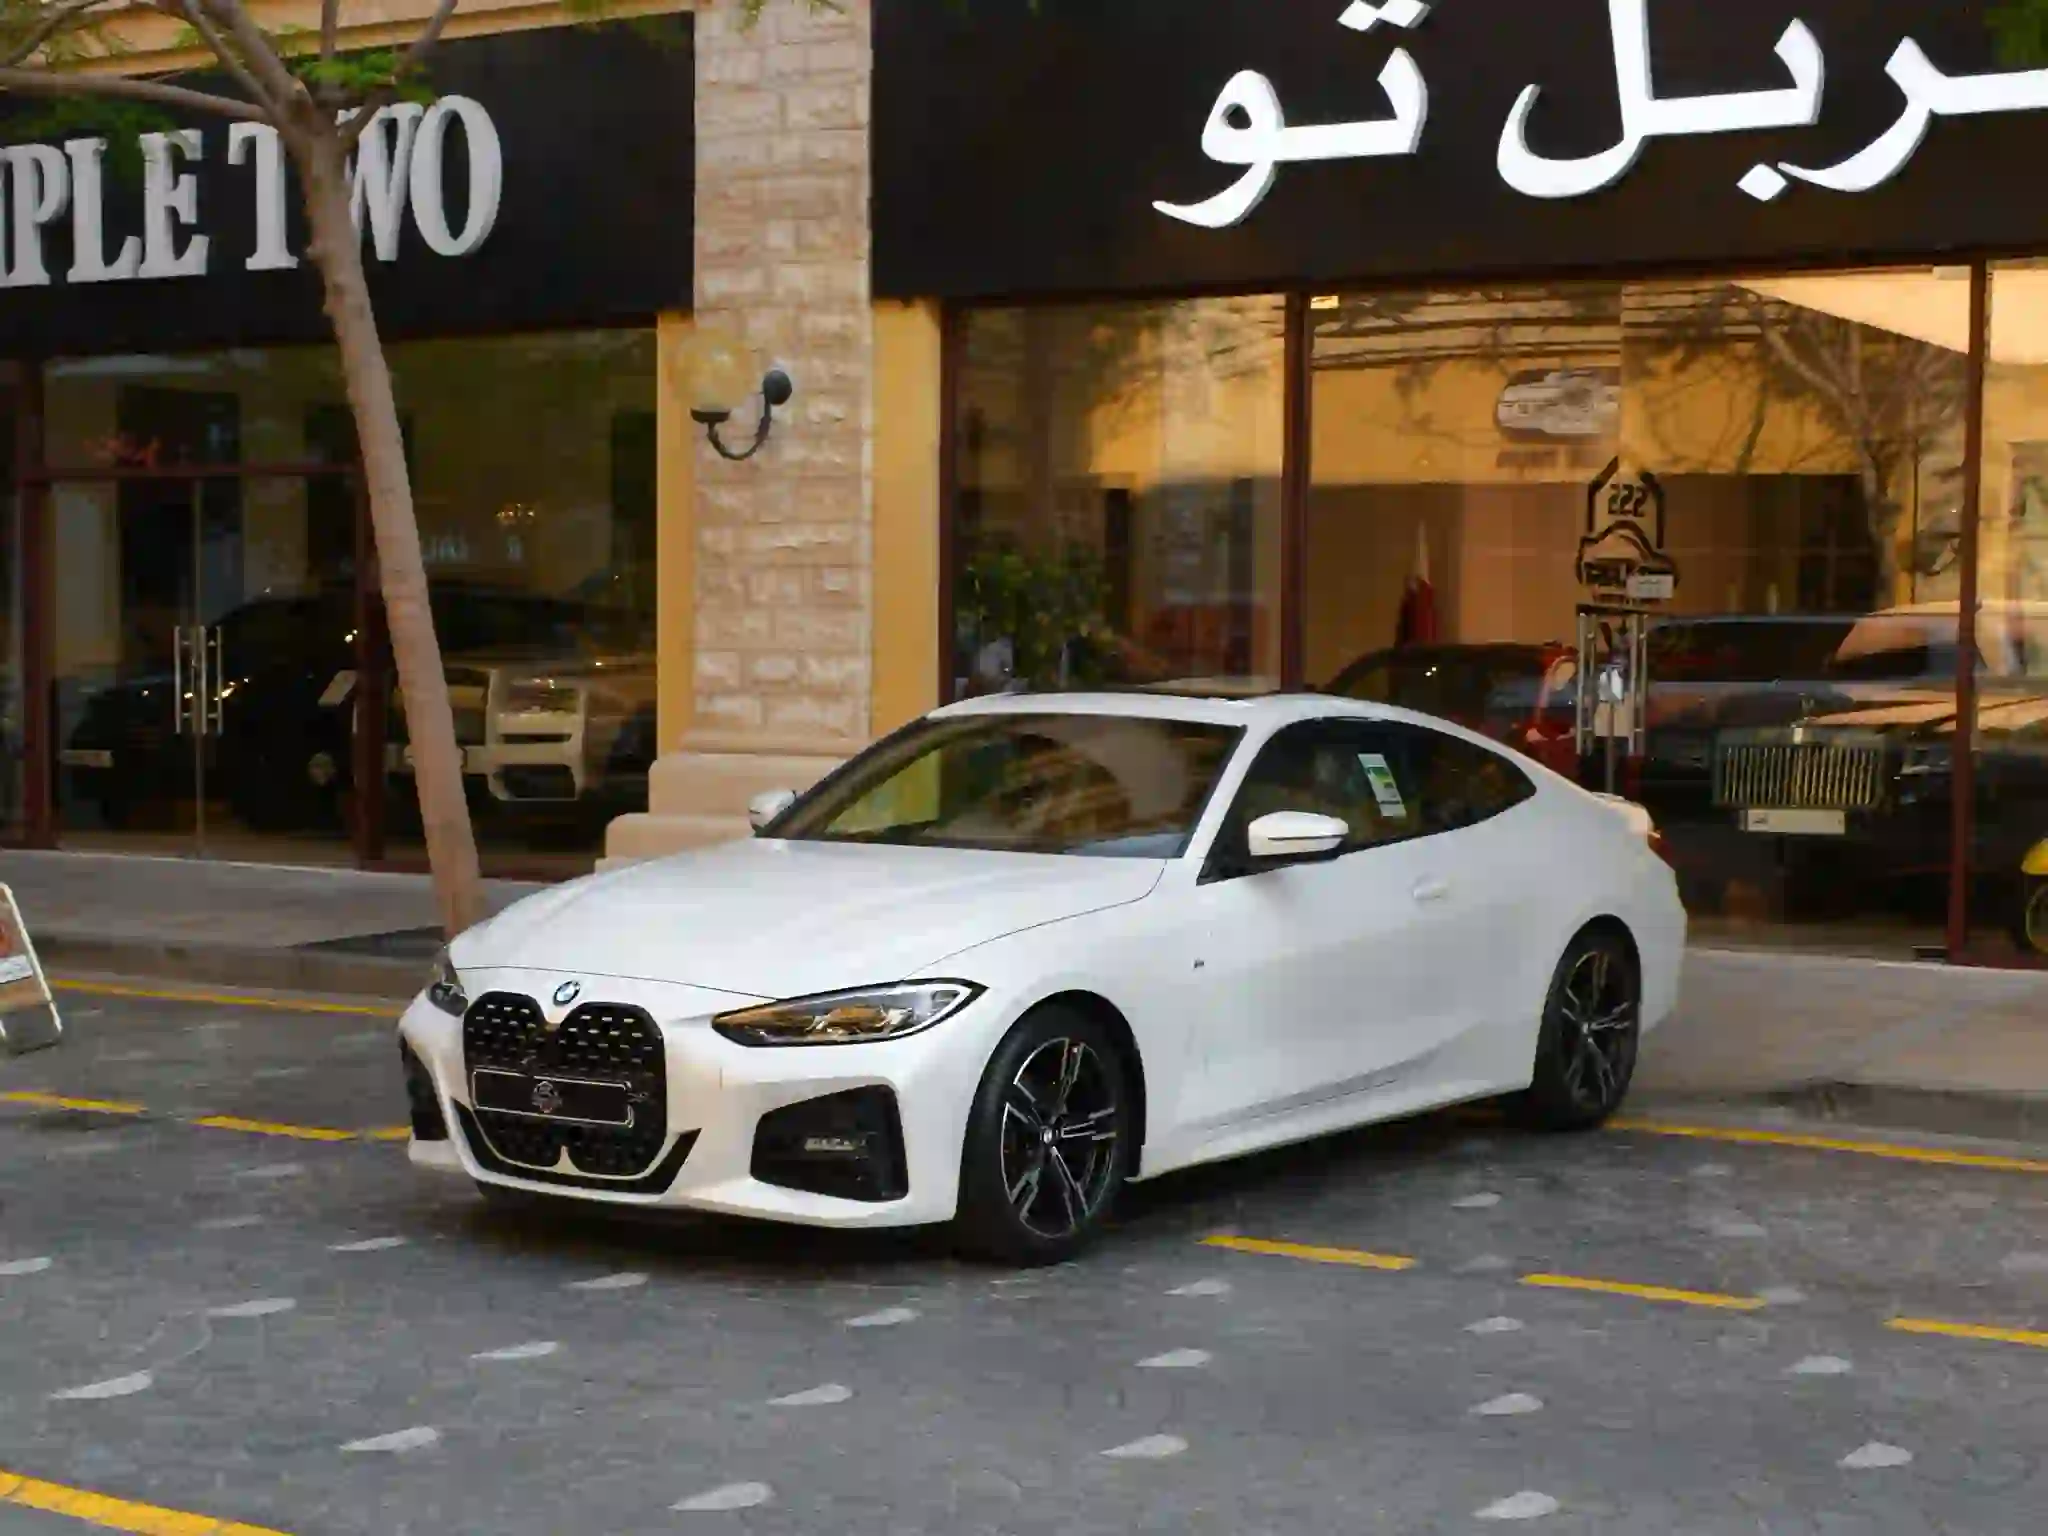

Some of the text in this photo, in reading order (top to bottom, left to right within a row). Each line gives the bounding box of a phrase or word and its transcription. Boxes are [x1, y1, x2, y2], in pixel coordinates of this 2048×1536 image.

[0, 94, 502, 288] PLE TWO
[1152, 0, 1430, 228] تو
